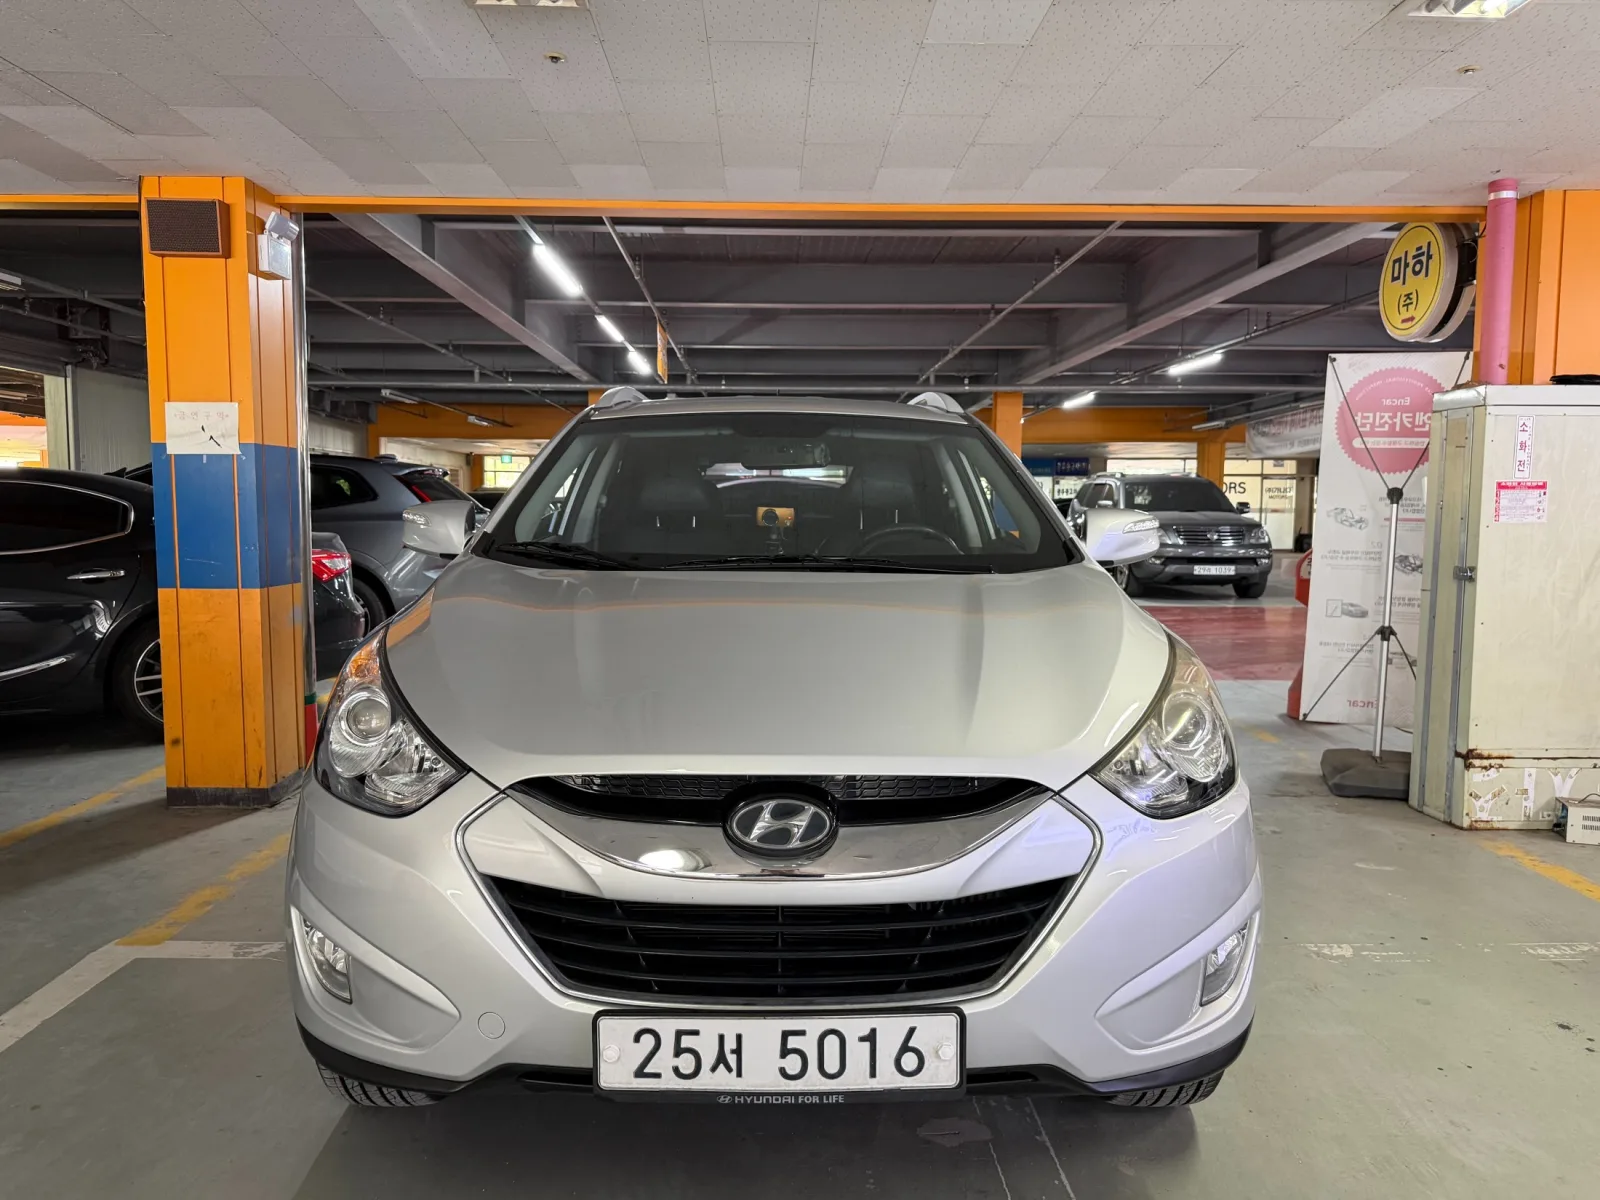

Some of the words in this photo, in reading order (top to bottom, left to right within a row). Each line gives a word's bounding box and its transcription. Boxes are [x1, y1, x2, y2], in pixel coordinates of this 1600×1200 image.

[1390, 241, 1433, 285] 마하
[1397, 289, 1419, 316] (주)
[1517, 421, 1529, 472] 소화전
[633, 1027, 743, 1080] 25서
[778, 1026, 926, 1081] 5016
[734, 1095, 795, 1105] HYUNDAI
[798, 1095, 820, 1104] FOR
[822, 1095, 845, 1104] LIFE
